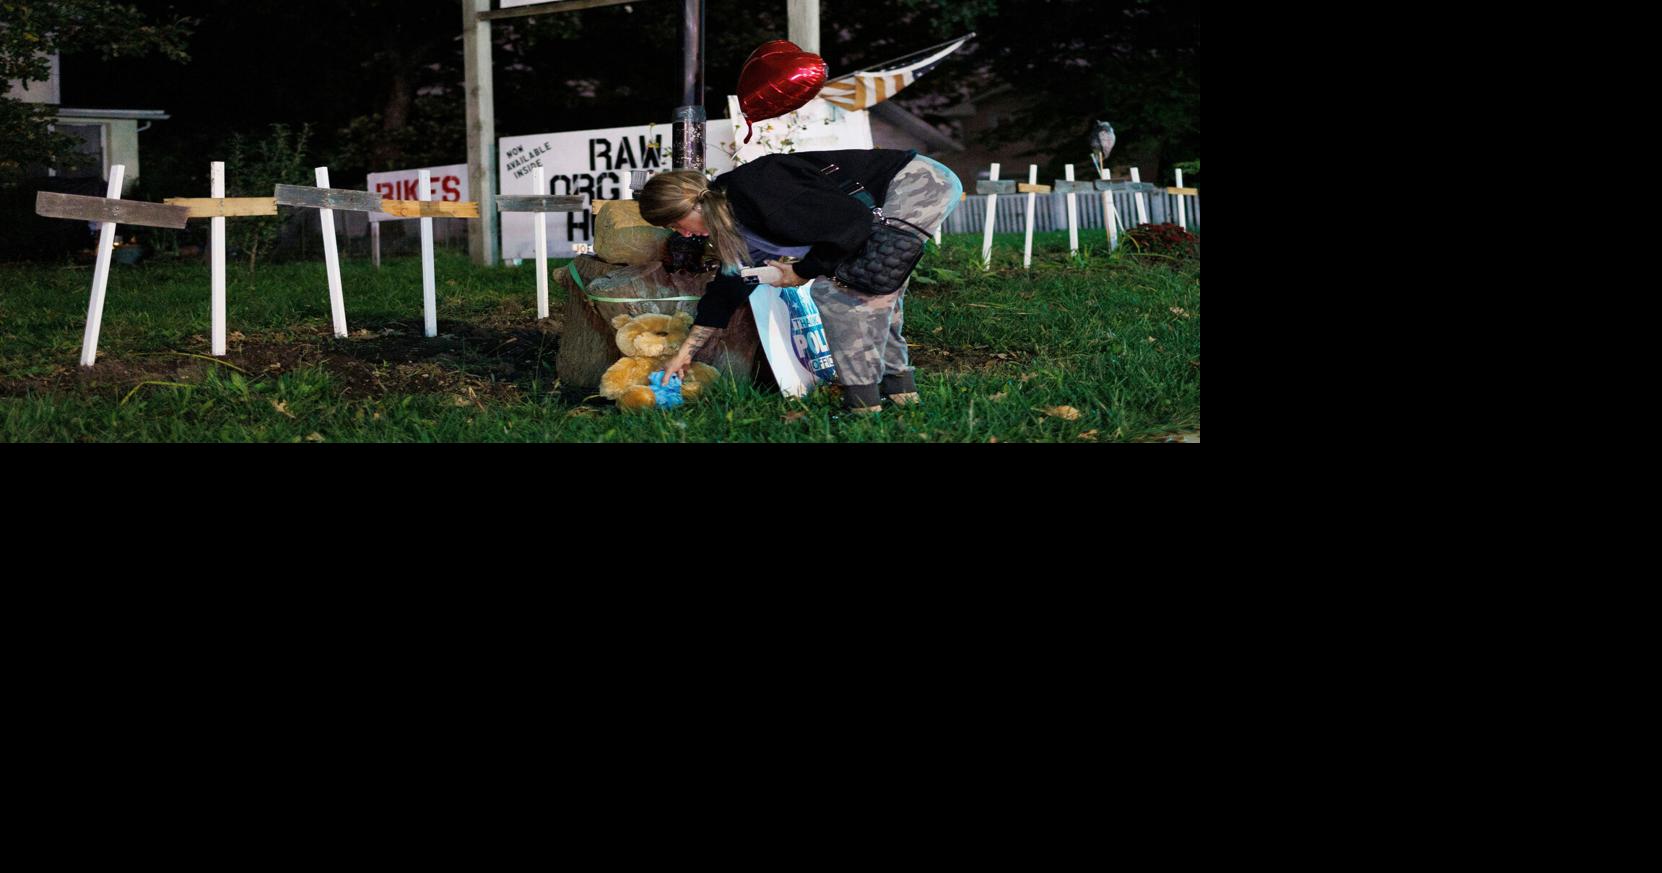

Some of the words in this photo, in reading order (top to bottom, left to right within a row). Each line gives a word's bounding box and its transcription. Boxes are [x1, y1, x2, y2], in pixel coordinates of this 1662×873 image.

[506, 145, 524, 159] NOW
[506, 141, 552, 171] AVAILABLE
[589, 134, 662, 171] RAW
[513, 159, 543, 179] INSIDE
[550, 172, 620, 206] ORG
